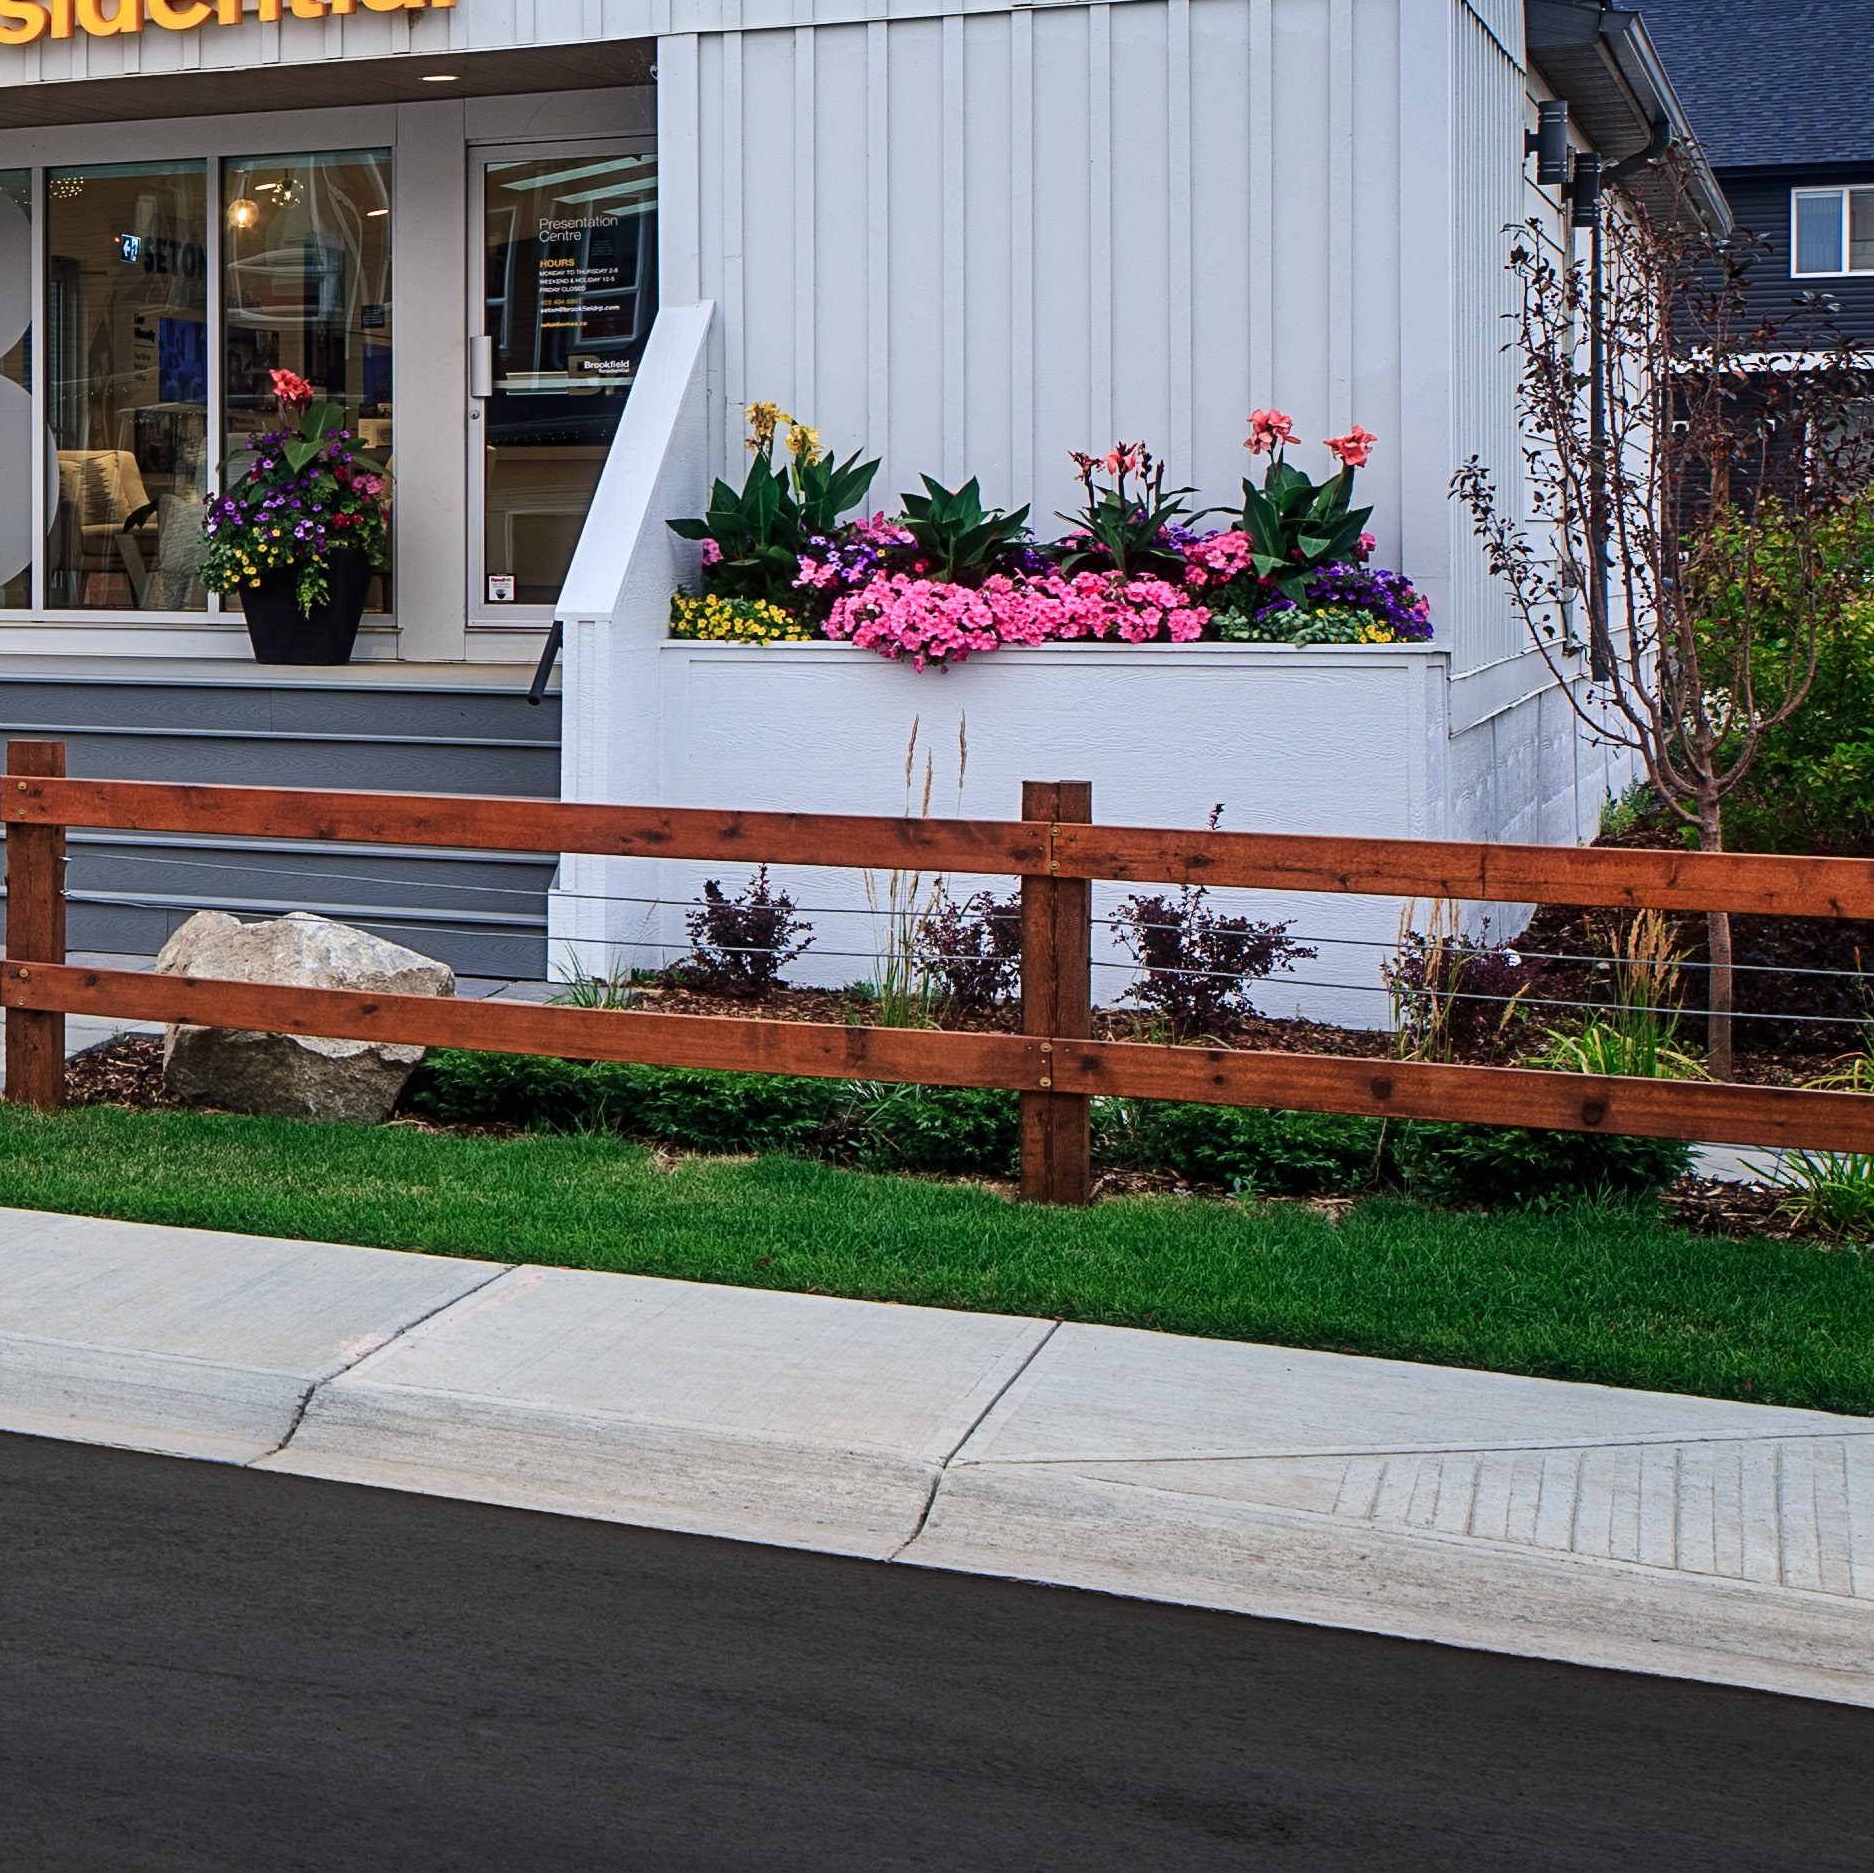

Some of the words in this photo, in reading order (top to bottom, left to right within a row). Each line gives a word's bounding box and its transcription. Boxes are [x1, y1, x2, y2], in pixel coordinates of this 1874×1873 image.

[539, 215, 618, 230] Presentation
[539, 230, 581, 242] Centre
[539, 259, 575, 268] HOURS
[584, 360, 630, 369] Brookfield
